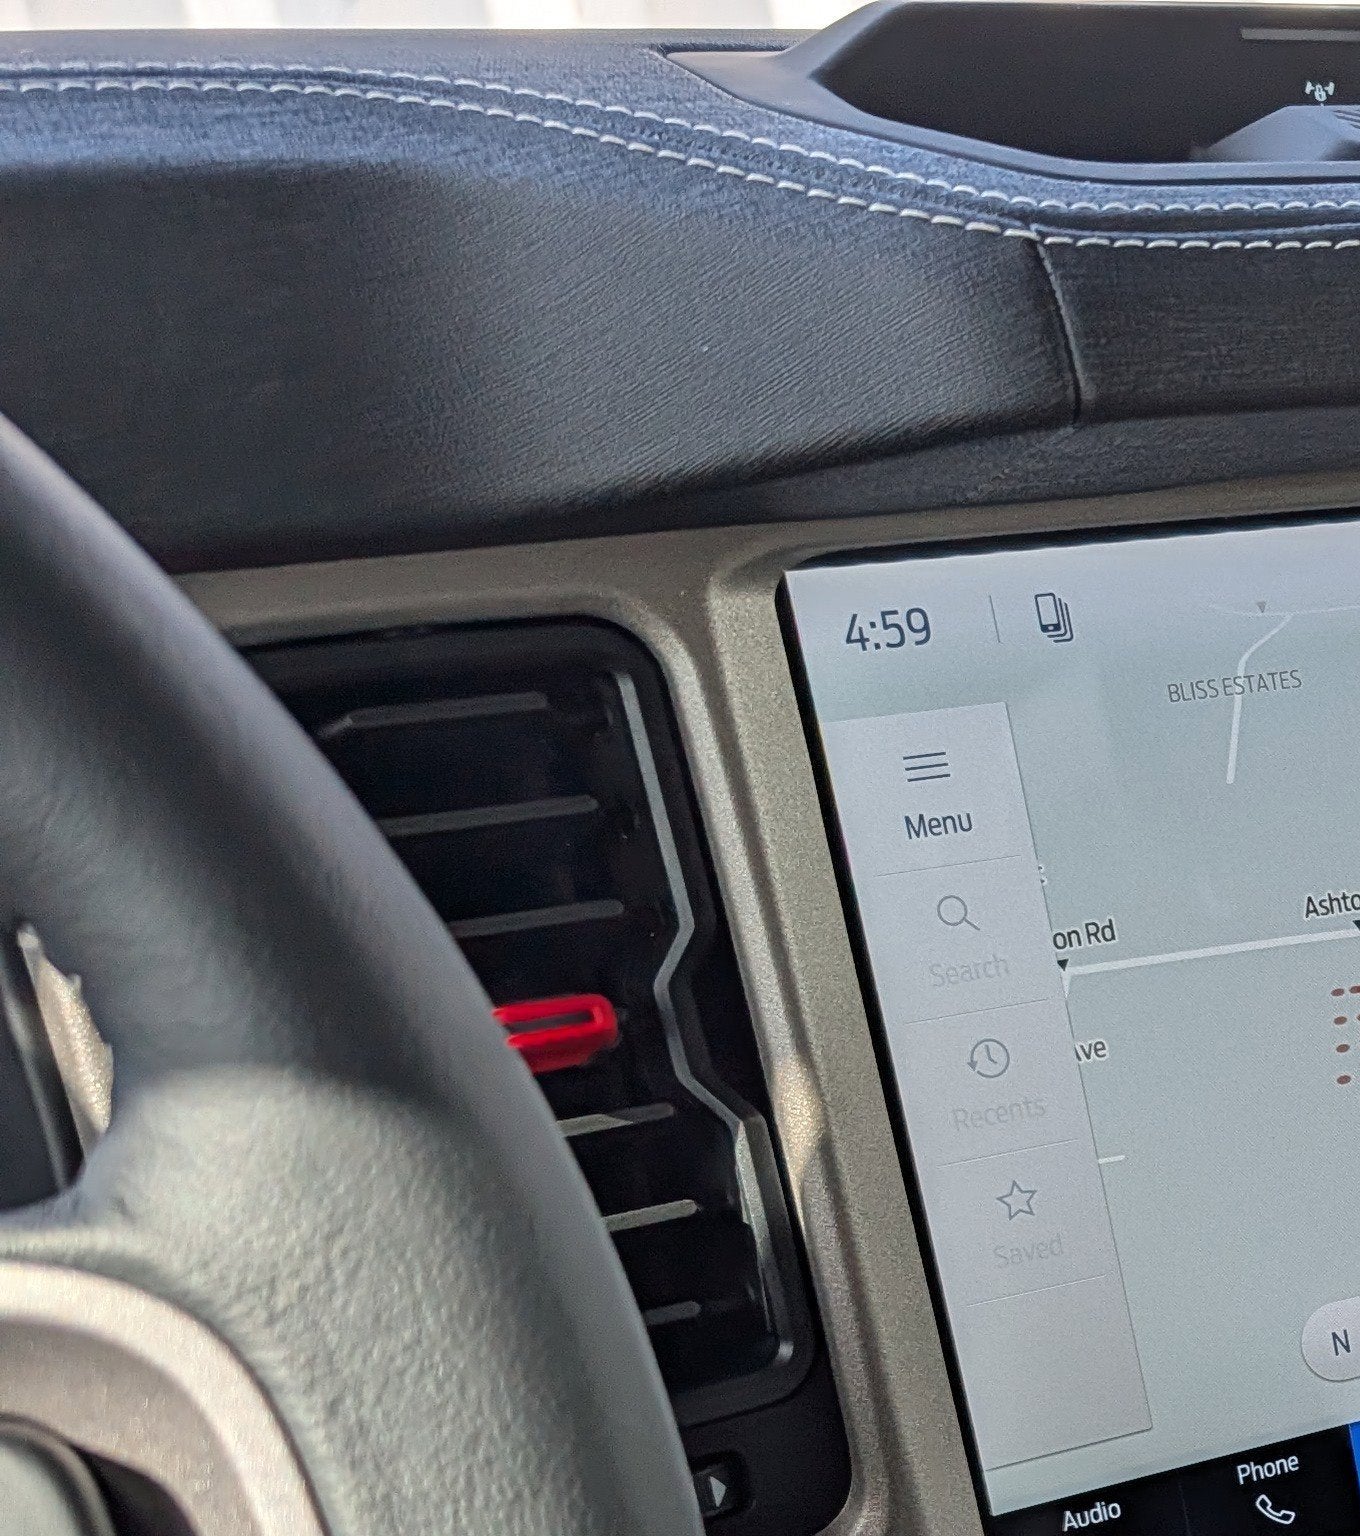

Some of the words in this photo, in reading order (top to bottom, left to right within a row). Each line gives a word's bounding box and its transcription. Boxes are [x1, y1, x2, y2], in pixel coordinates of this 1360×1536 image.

[845, 608, 932, 653] 4:59
[1167, 678, 1219, 704] BLISS
[1221, 668, 1304, 698] ESTATES
[904, 809, 974, 841] Menu
[1084, 919, 1116, 946] Rd
[929, 954, 1010, 988] Search
[953, 1096, 1047, 1133] Recents
[993, 1233, 1064, 1269] Saved
[1331, 1330, 1352, 1356] N
[1236, 1453, 1300, 1485] Phone
[1062, 1499, 1122, 1532] Audio
